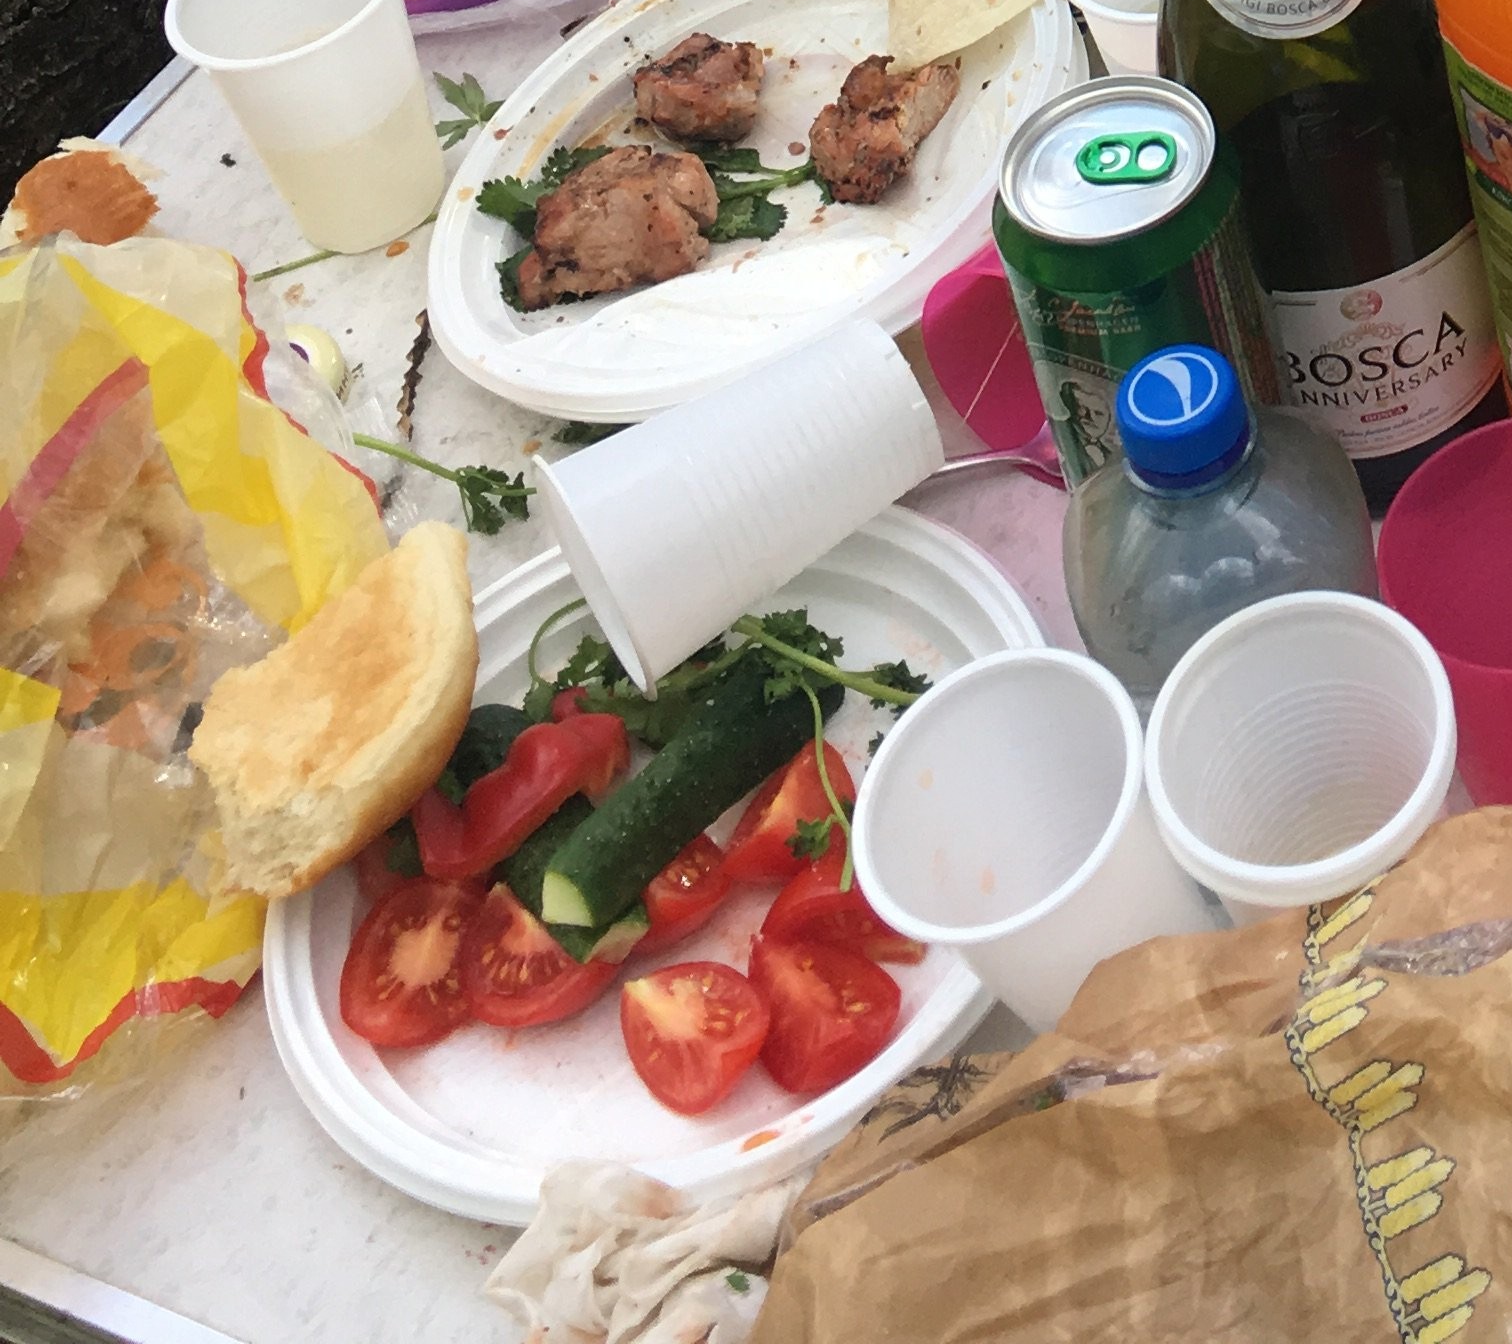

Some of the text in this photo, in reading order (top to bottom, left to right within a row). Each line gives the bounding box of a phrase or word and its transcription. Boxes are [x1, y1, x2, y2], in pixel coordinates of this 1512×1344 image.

[1266, 0, 1318, 16] BOSCA
[1285, 311, 1465, 388] BOSCA
[1299, 337, 1468, 407] NNIVERSARY
